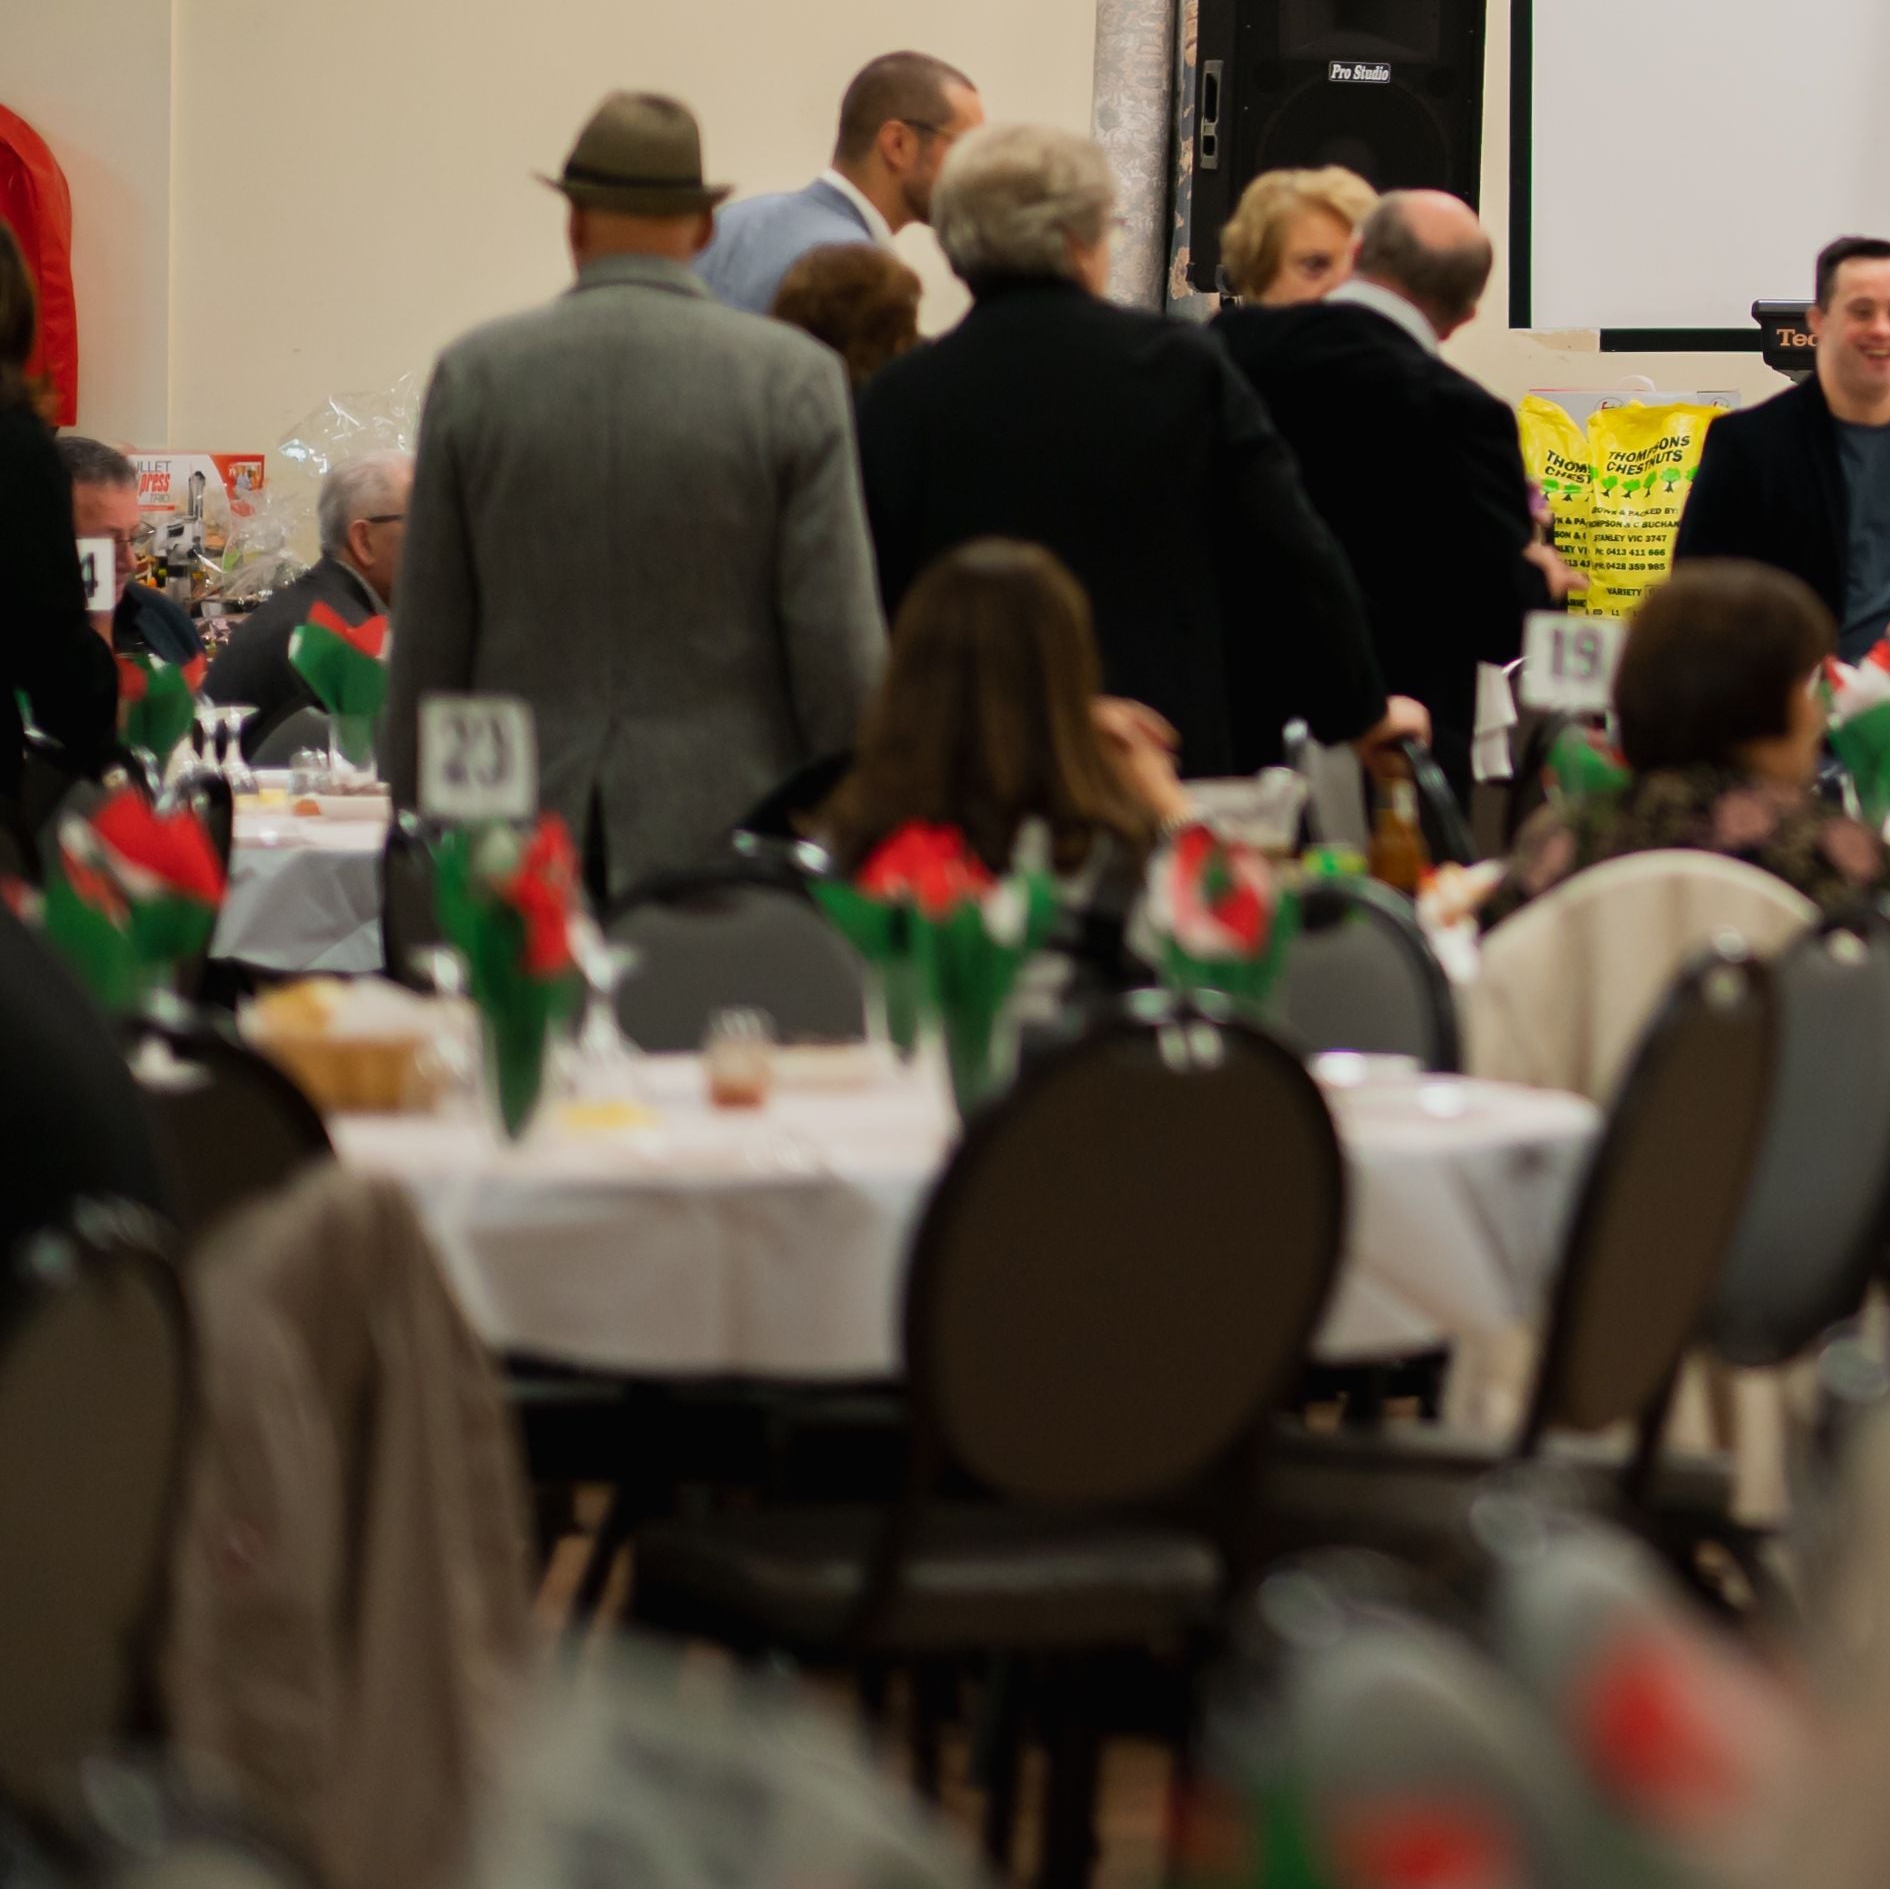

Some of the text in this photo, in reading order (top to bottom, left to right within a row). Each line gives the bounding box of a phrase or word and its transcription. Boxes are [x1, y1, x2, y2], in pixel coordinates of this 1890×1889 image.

[1330, 64, 1389, 81] Pro Studio
[1606, 449, 1684, 475] CHESTNUTS
[1607, 435, 1692, 464] THOMPSONS
[1627, 534, 1643, 543] VIC
[1606, 587, 1642, 597] VARIETY
[1549, 628, 1604, 683] 19
[443, 712, 514, 788] 23
